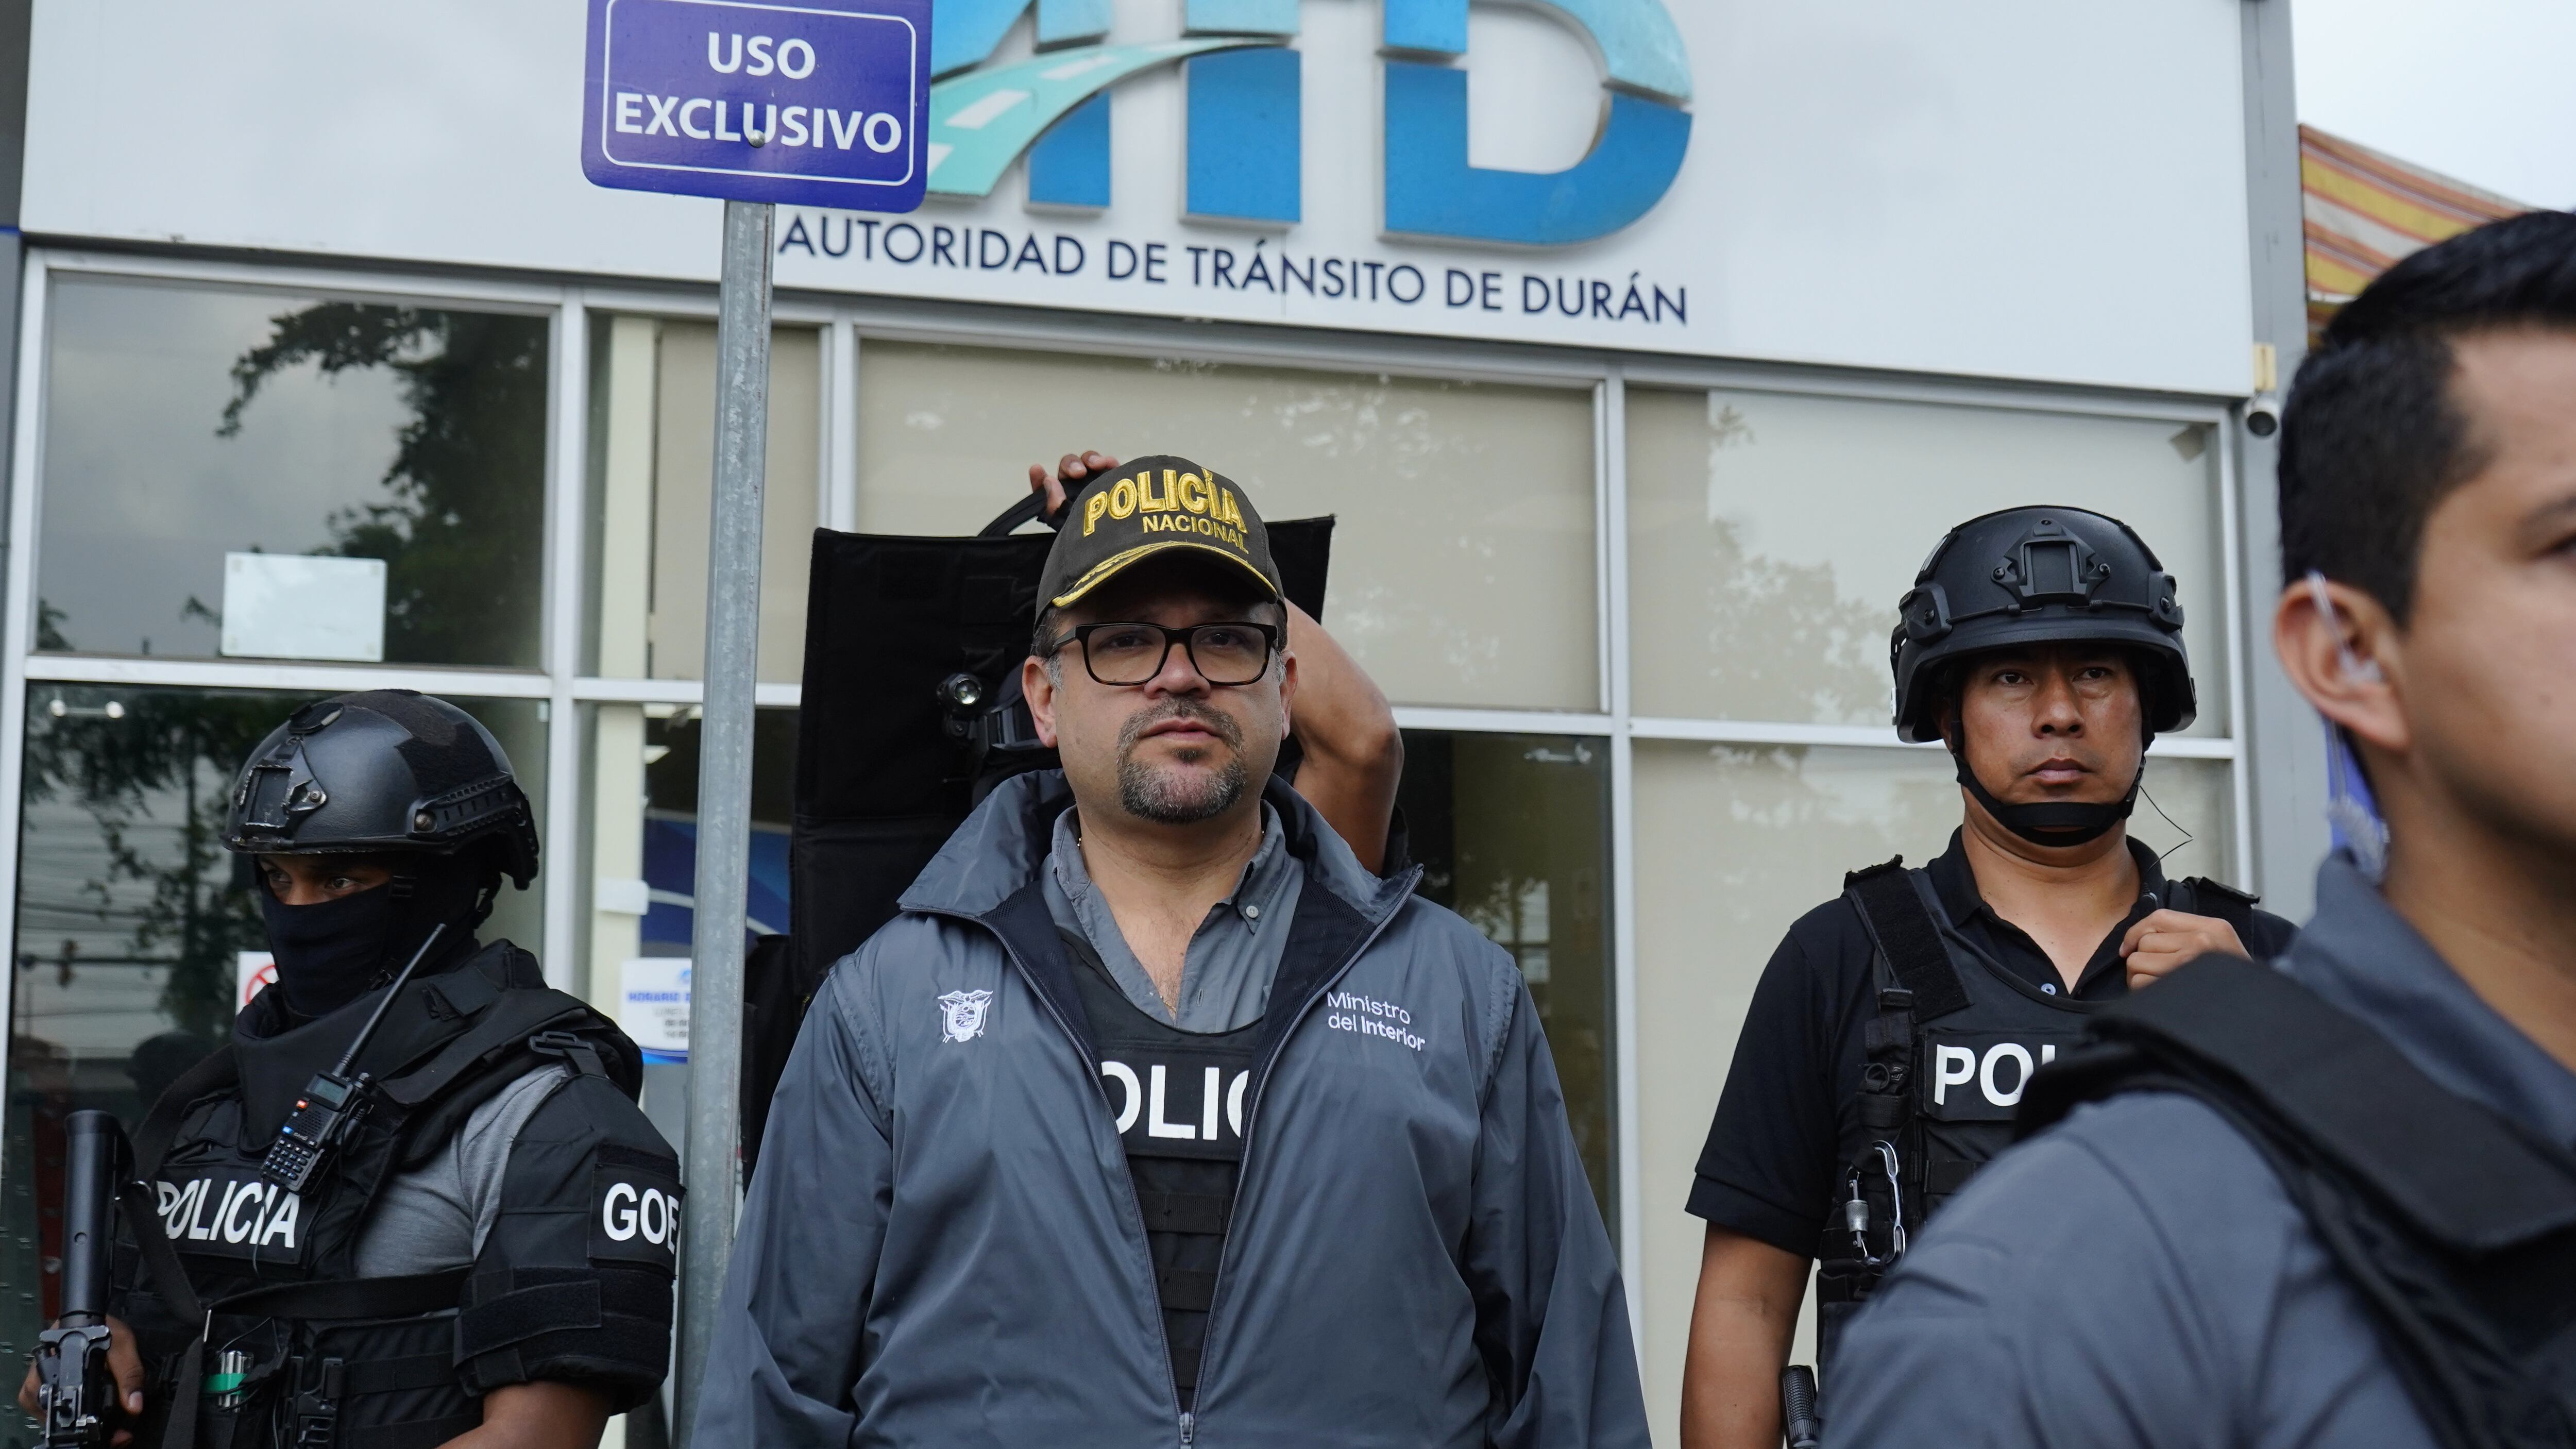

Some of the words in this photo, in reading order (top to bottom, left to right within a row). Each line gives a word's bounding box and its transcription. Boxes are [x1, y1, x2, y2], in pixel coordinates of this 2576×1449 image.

[708, 31, 816, 79] USO
[615, 92, 902, 154] EXCLUSIVO
[778, 214, 1085, 275] AUTORIDAD
[1108, 240, 1168, 283] DE
[1185, 239, 1425, 305] TRÁNSITO
[1446, 269, 1503, 310] DE
[1522, 271, 1687, 325] DURÁN
[1083, 467, 1248, 537] POLICÍA
[1142, 514, 1249, 554] NACIONAL
[1327, 991, 1411, 1024] Ministro
[1328, 1012, 1358, 1032] del
[1361, 1015, 1426, 1051] Interior
[156, 1178, 300, 1249] POLICIA
[603, 1183, 680, 1255] GOE
